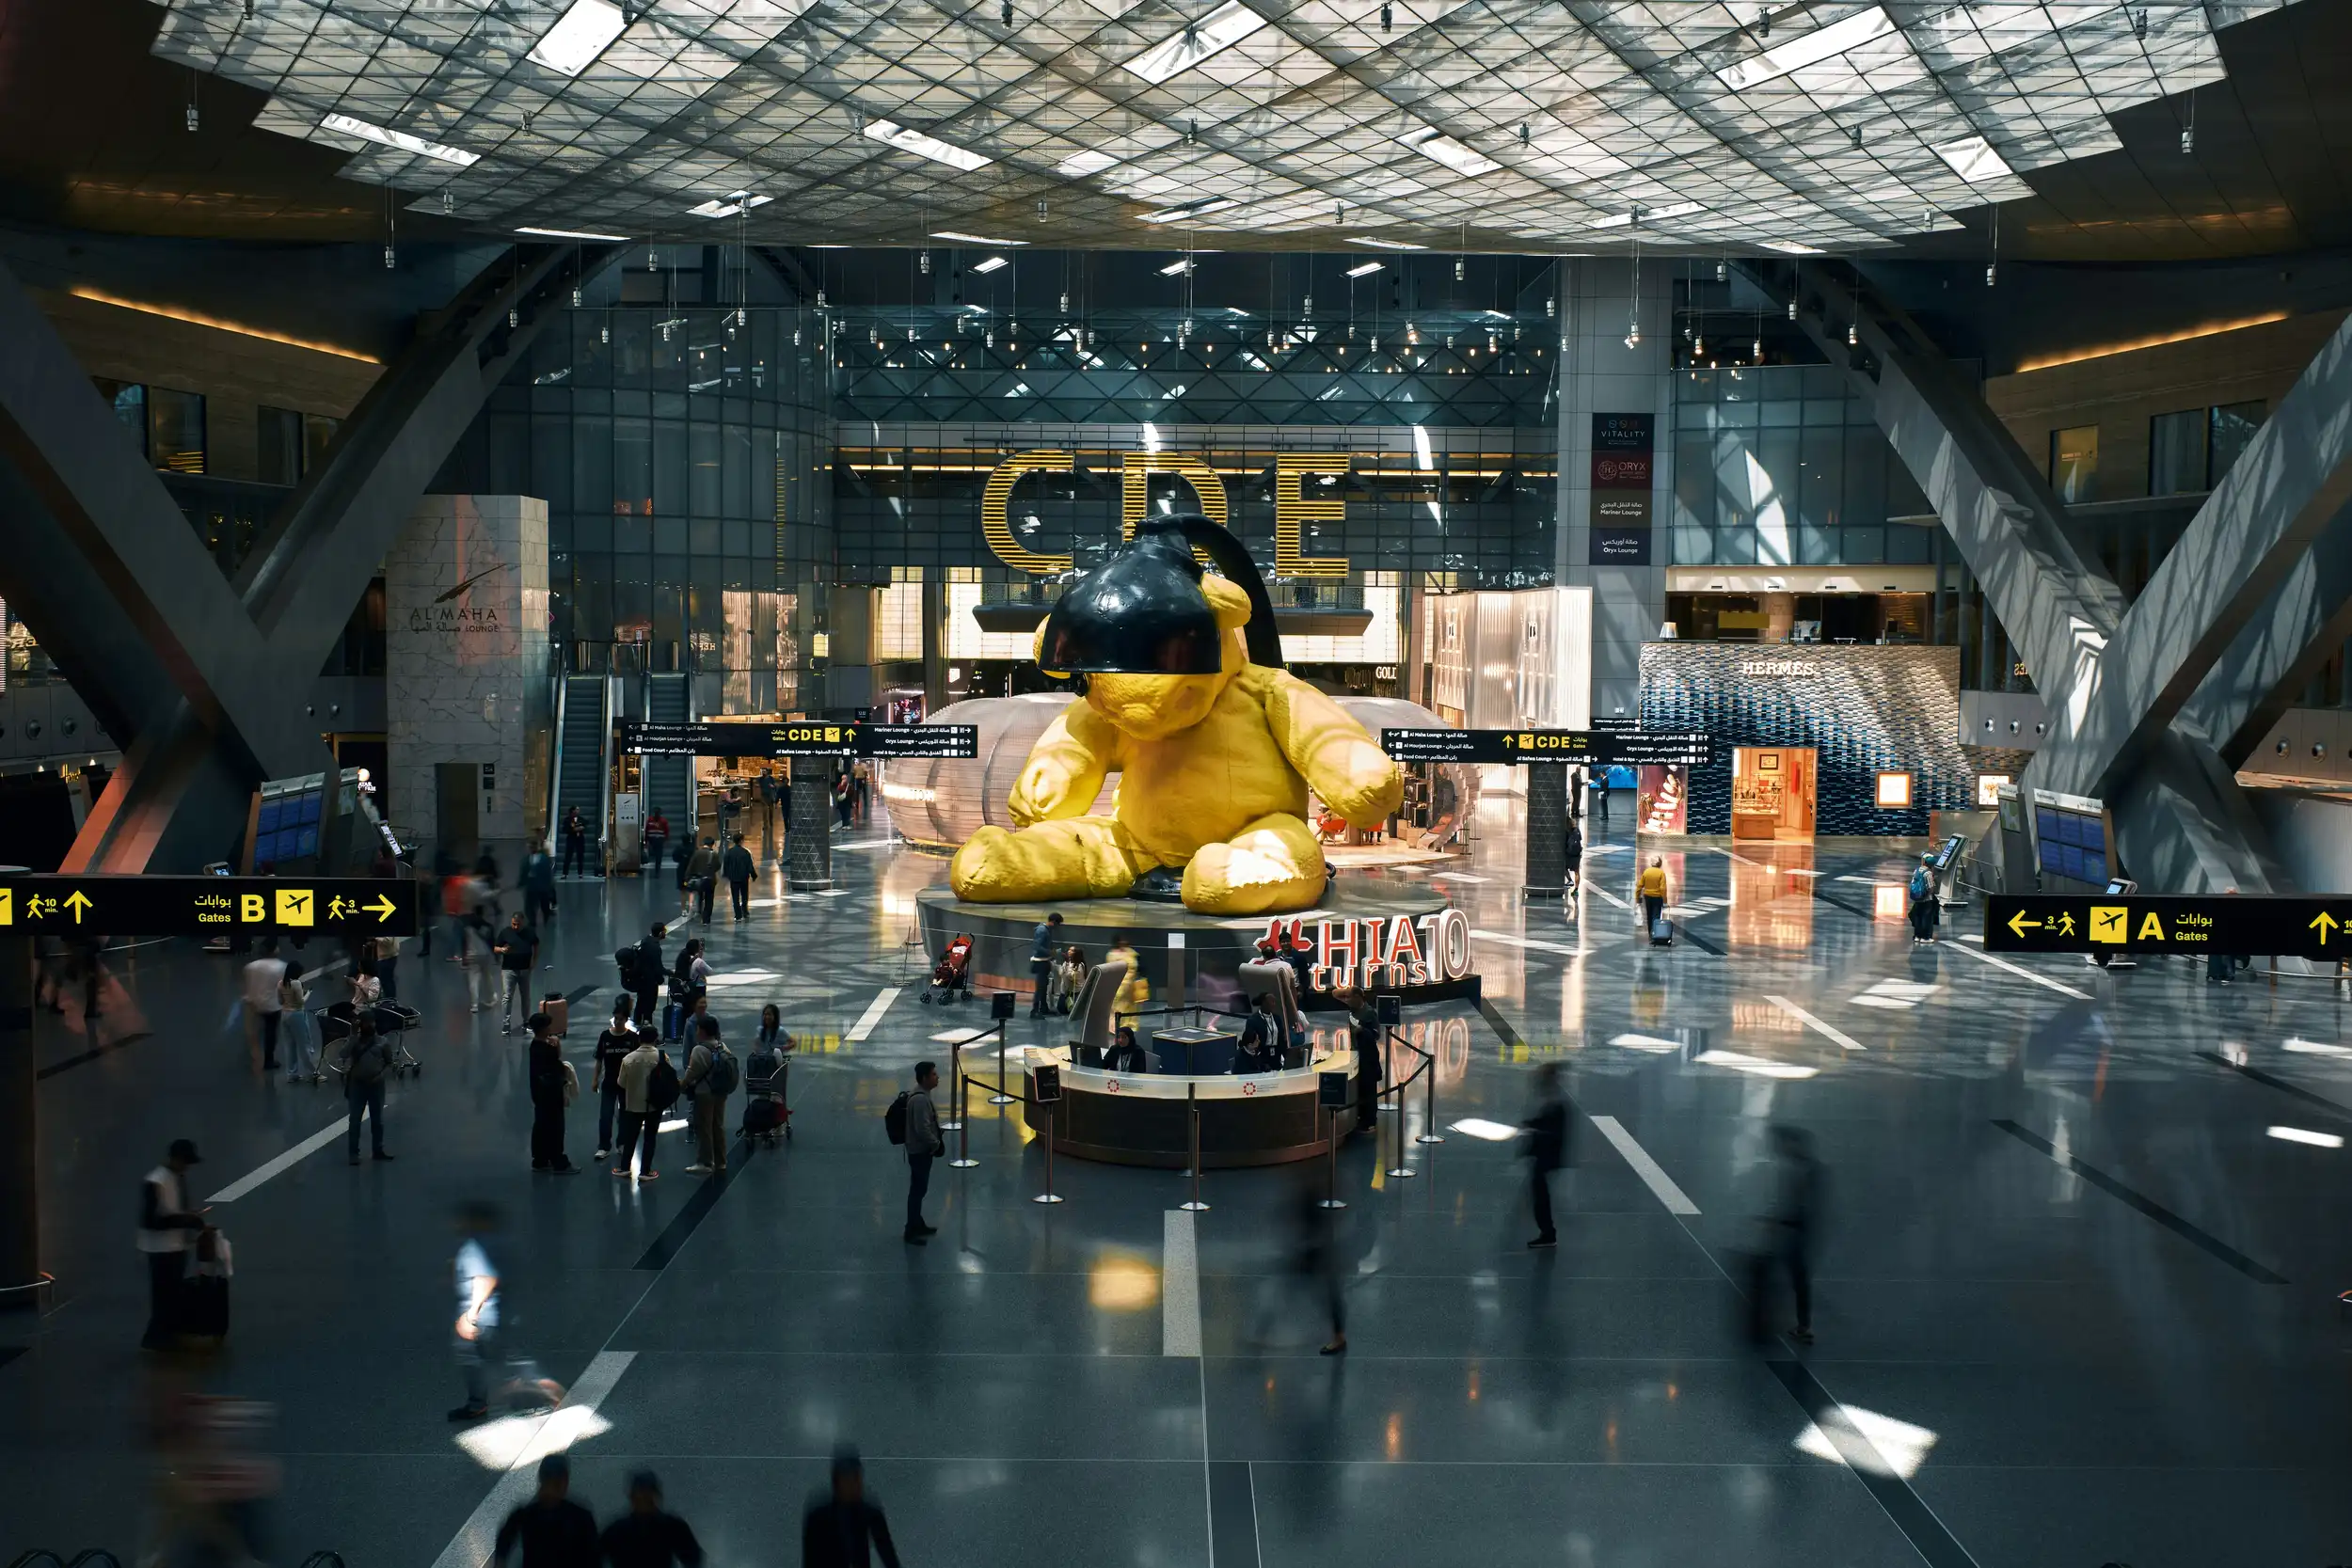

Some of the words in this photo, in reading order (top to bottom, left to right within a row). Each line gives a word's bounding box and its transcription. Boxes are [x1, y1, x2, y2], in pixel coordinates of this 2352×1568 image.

[1618, 462, 1645, 470] ORYX
[411, 608, 432, 620] AL
[440, 608, 497, 620] MAHA
[788, 729, 822, 741] CDE
[1537, 736, 1570, 748] CDE
[195, 895, 231, 907] بوابات
[242, 895, 265, 922] B
[199, 913, 231, 923] Gates
[2176, 913, 2213, 926] بوابات
[2137, 912, 2165, 940] A
[2176, 931, 2208, 941] Gates
[1318, 915, 1422, 968] HIA
[1417, 909, 1470, 982] 10
[1308, 961, 1426, 990] turns
